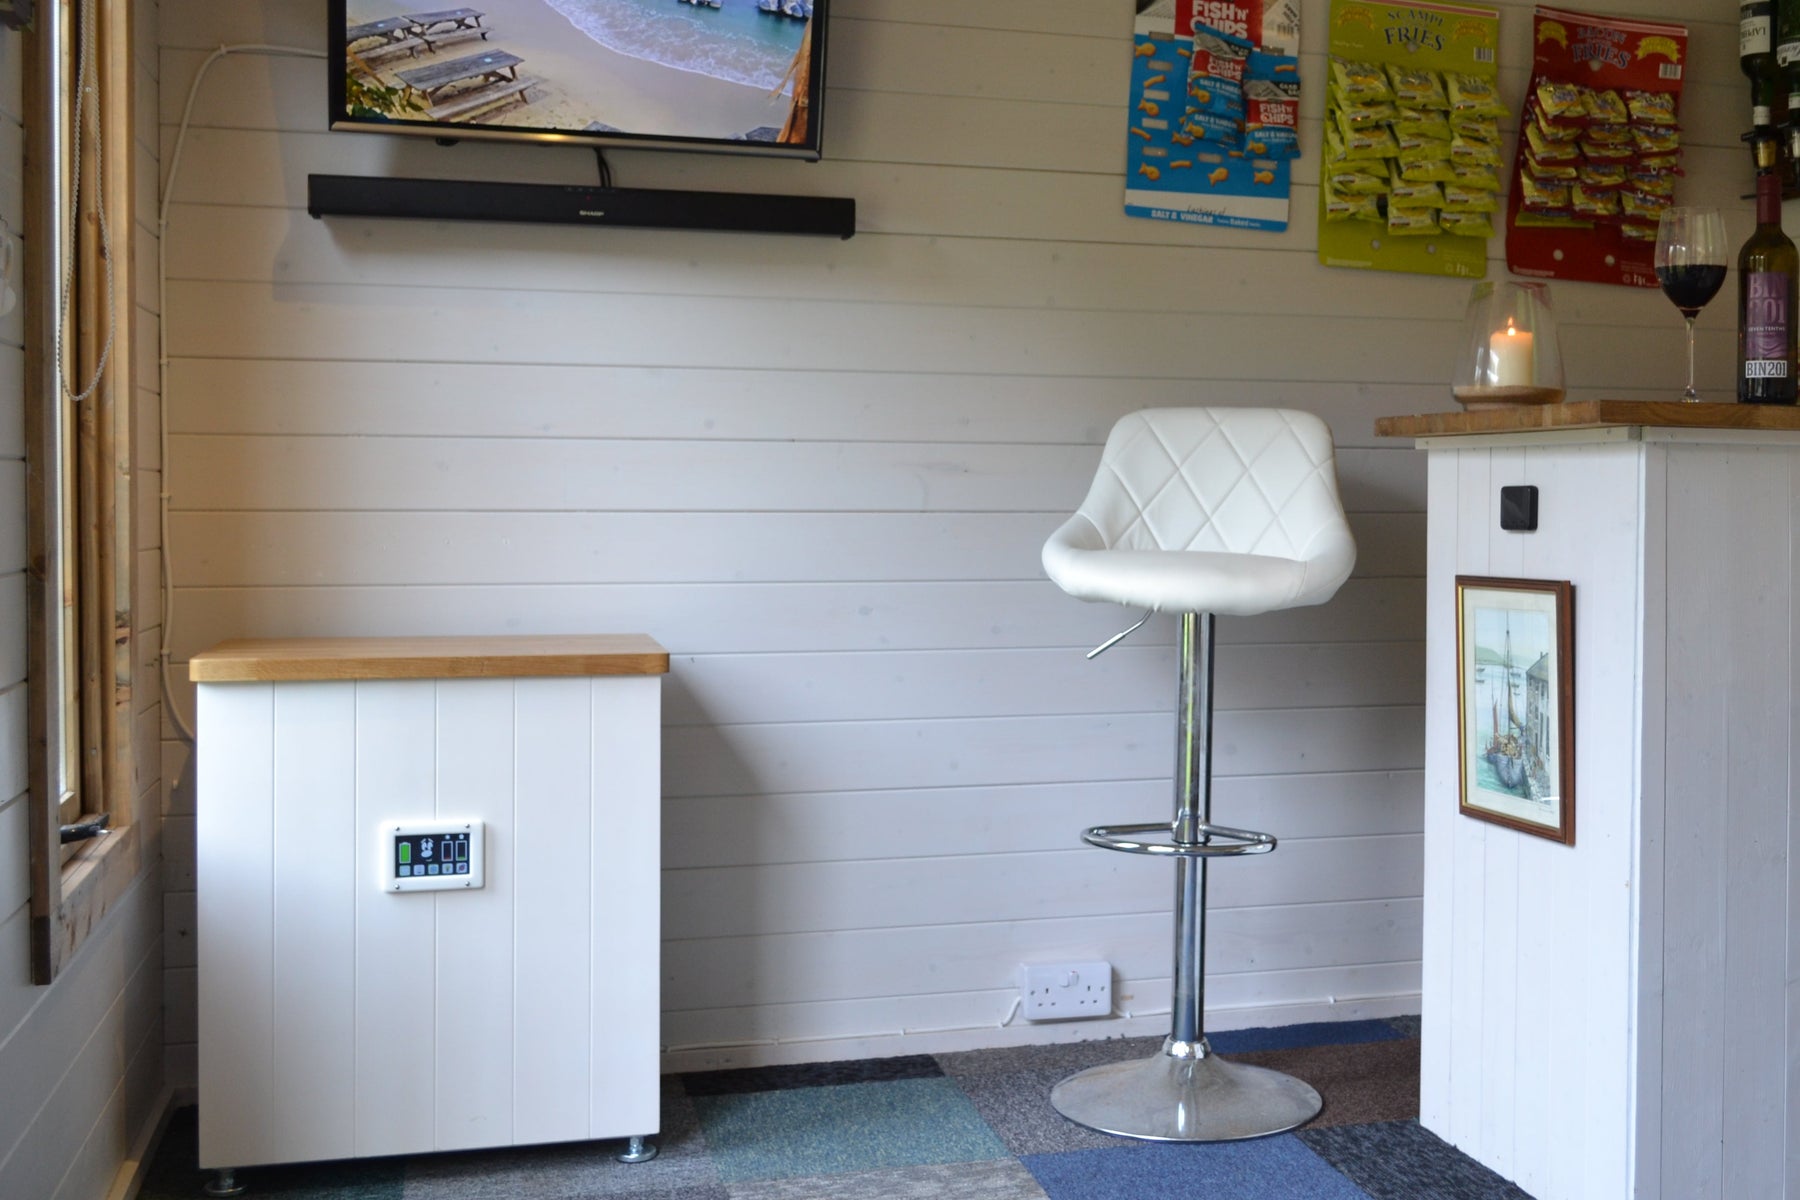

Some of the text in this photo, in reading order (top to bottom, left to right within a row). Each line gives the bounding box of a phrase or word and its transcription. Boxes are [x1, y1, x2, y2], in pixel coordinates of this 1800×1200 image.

[1387, 9, 1444, 27] SCAMPI
[1384, 27, 1446, 51] FRIES
[1578, 27, 1626, 44] BACON
[1572, 43, 1631, 69] FRIES
[1207, 63, 1242, 80] CHIPS
[1260, 112, 1295, 125] CHIPS
[1151, 209, 1170, 219] SALT
[1180, 211, 1213, 224] VINEGAR
[1749, 274, 1784, 297] BIN
